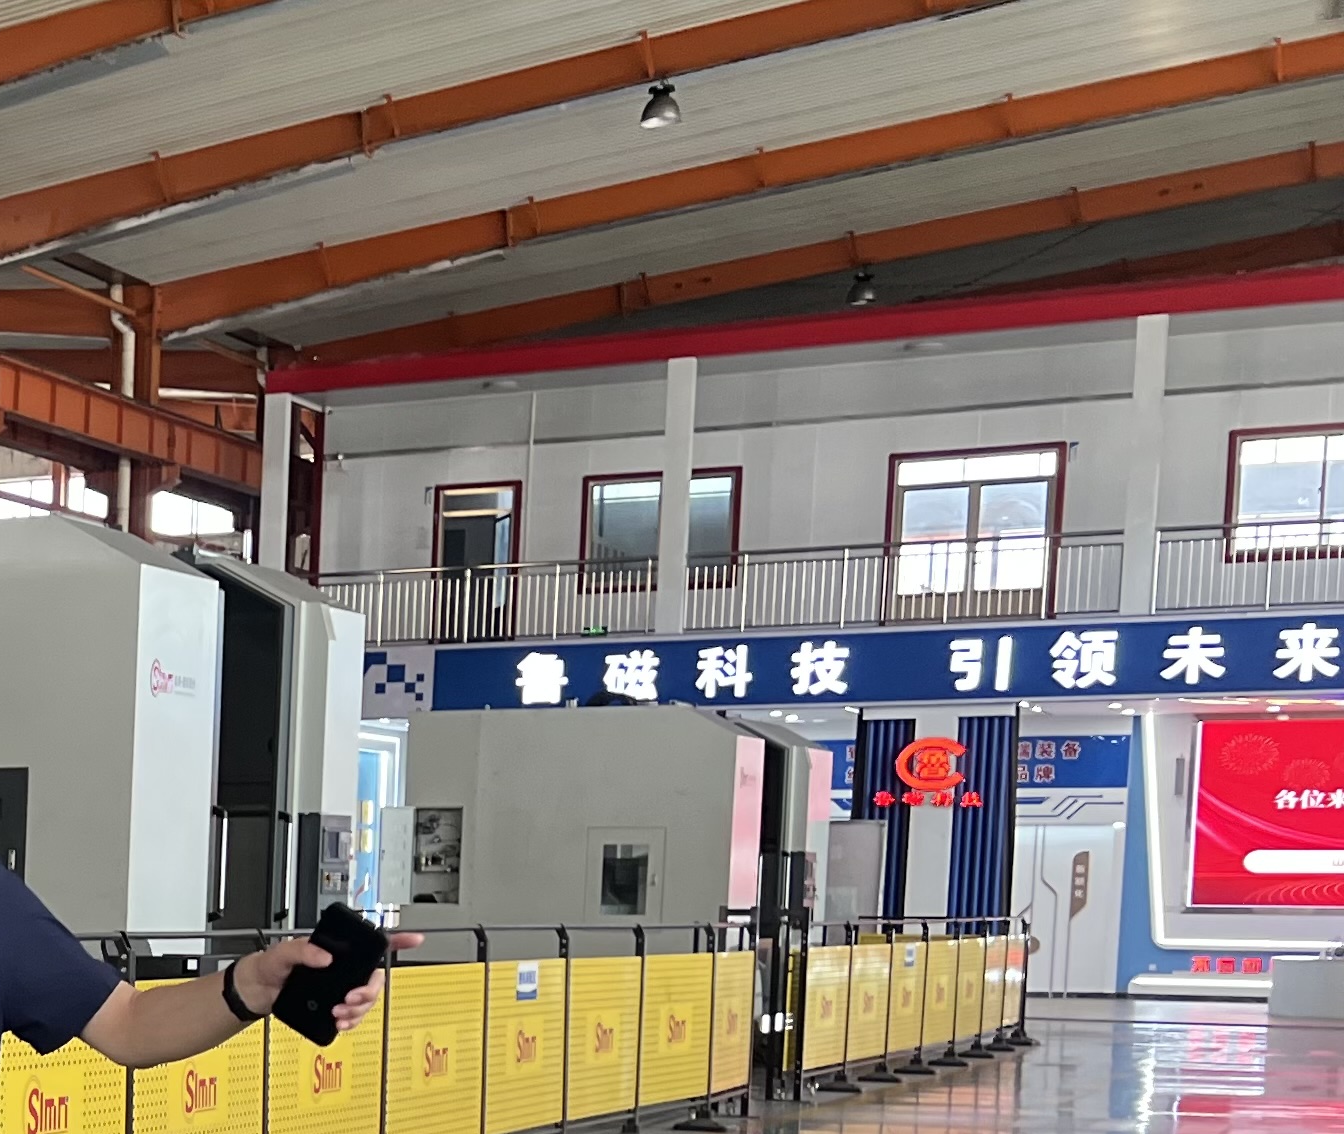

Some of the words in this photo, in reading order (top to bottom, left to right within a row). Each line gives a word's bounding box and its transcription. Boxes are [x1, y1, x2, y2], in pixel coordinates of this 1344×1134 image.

[515, 640, 850, 705] 鲁磁科技
[949, 622, 1341, 692] 引领未来
